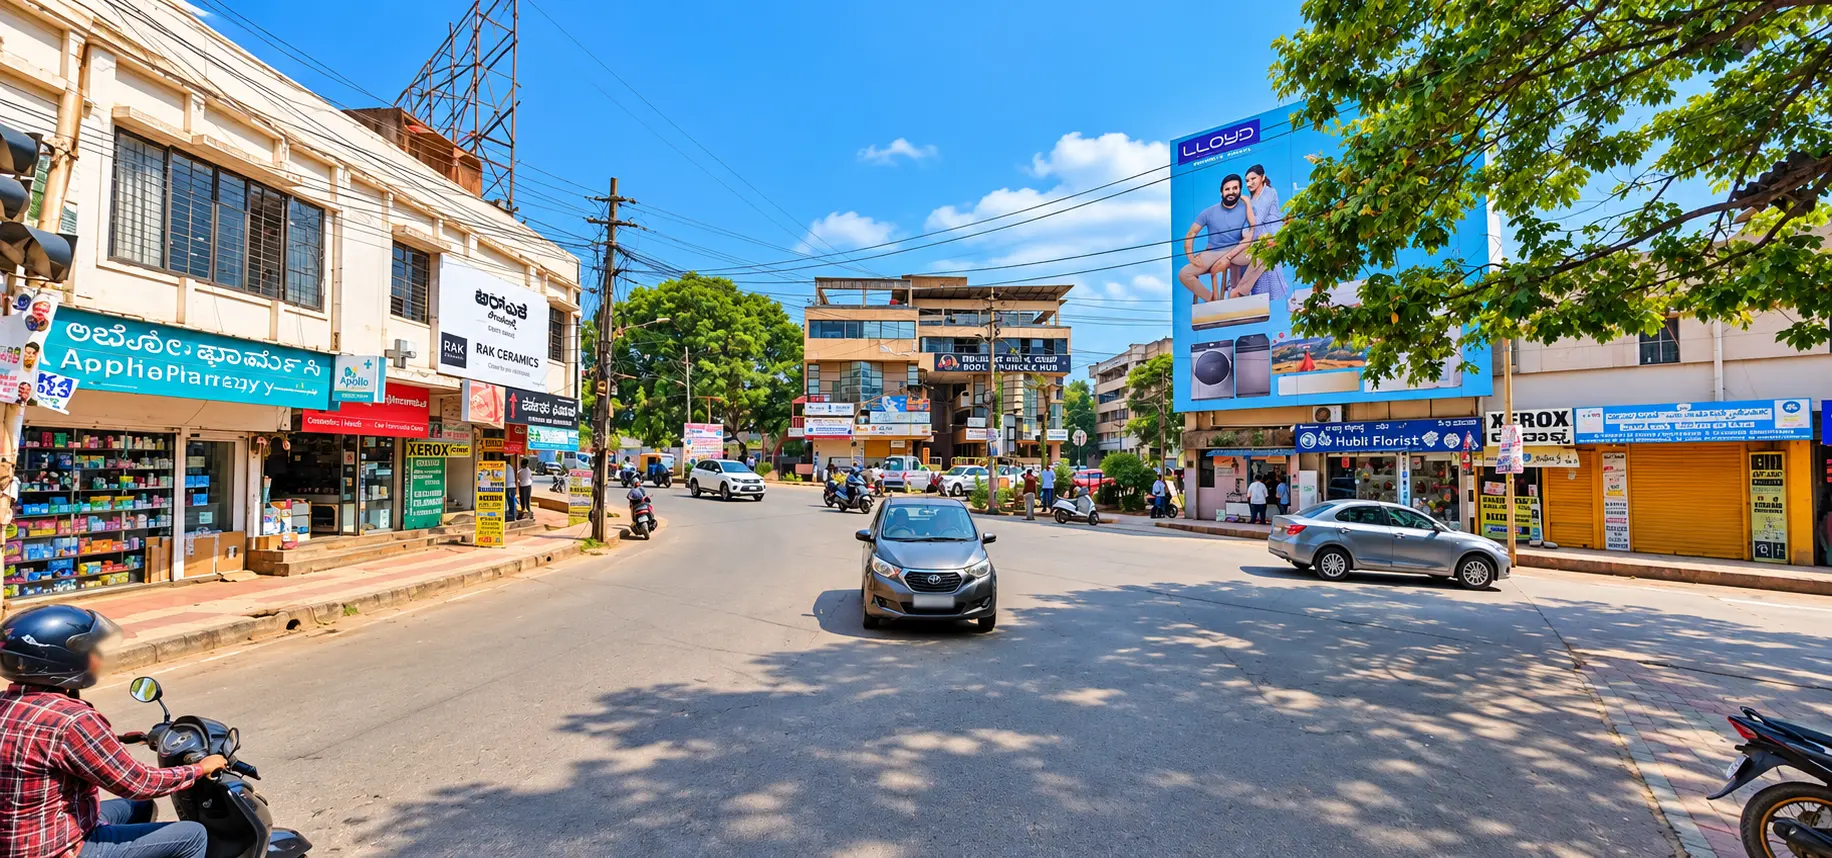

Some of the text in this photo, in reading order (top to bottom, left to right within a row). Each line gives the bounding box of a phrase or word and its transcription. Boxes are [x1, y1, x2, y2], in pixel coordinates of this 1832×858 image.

[1183, 126, 1254, 157] LLOYD
[444, 339, 465, 355] RAK
[476, 342, 495, 358] RAK
[497, 348, 540, 368] CERAMICS
[1040, 363, 1058, 371] HUB
[339, 376, 369, 388] Apollo
[1336, 434, 1420, 447] Hubli Florist
[408, 442, 449, 456] XEROX
